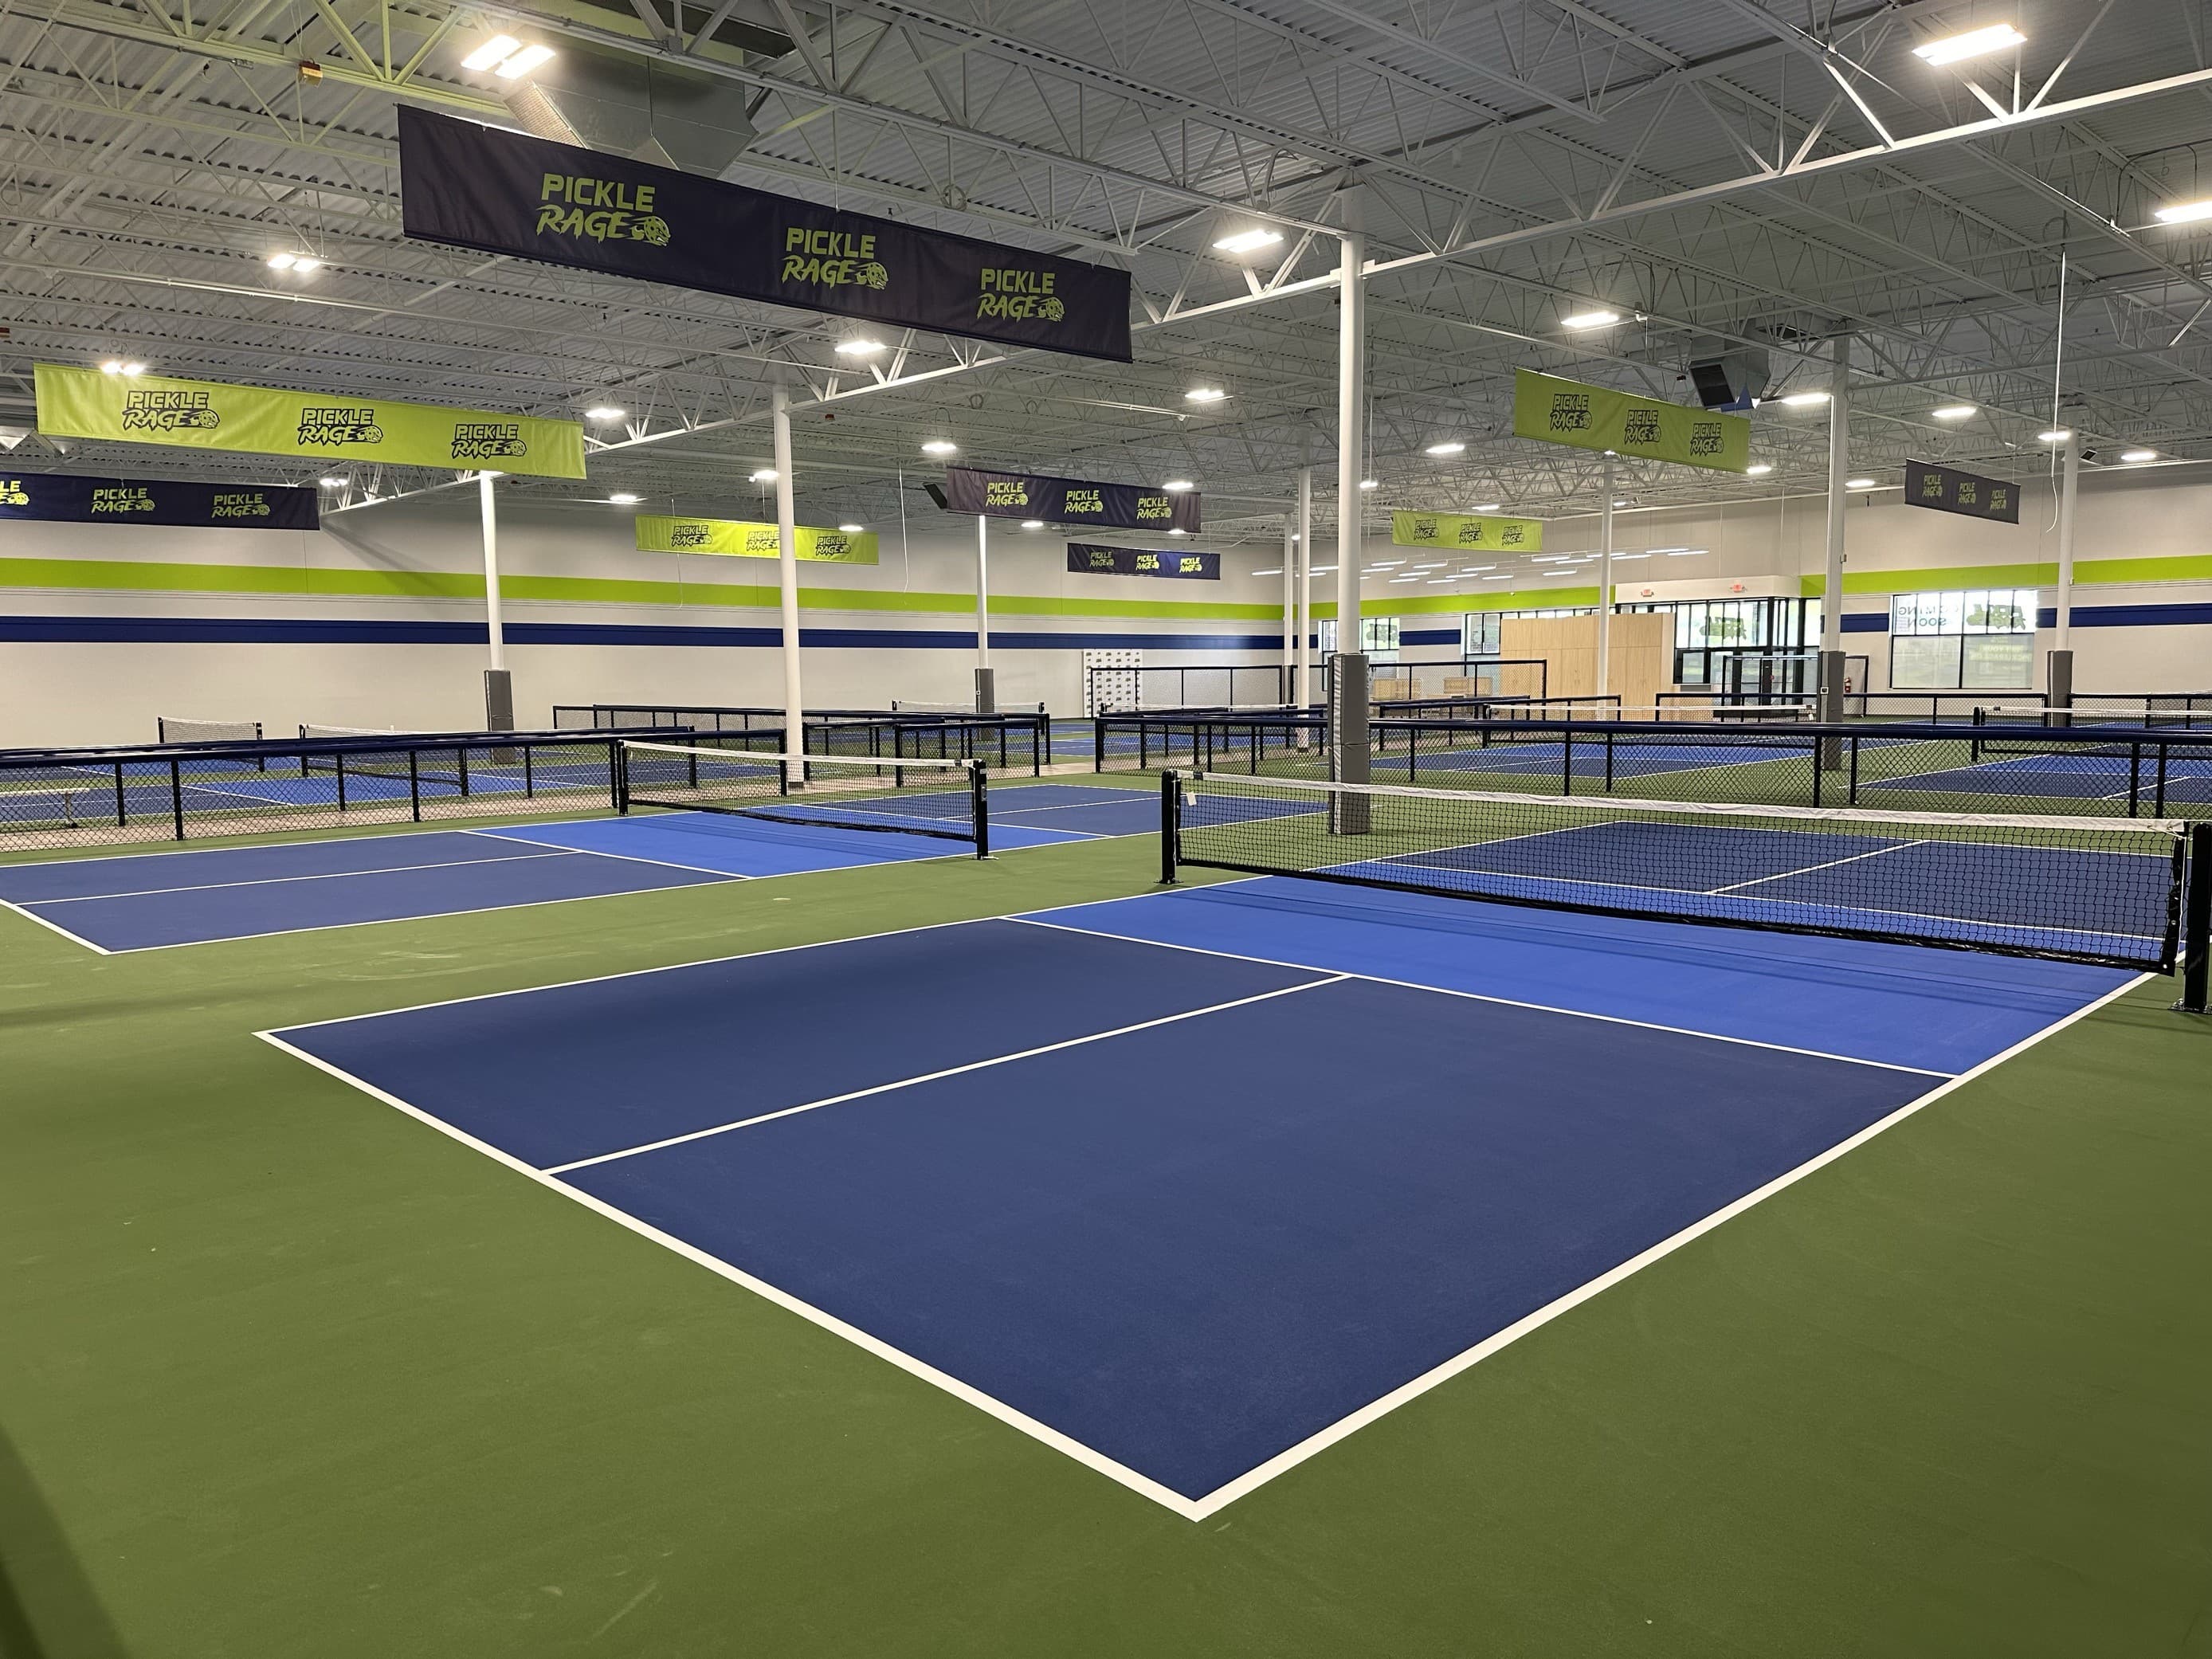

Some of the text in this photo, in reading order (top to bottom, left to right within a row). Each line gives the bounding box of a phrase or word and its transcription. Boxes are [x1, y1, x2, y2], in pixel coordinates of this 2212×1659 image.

[541, 172, 656, 213] PICKLE
[535, 204, 635, 244] RAGE
[786, 227, 876, 260] PICKLE
[782, 254, 860, 289] RAGE
[981, 268, 1056, 294] PICKLE
[977, 292, 1041, 323] RAGE
[127, 390, 209, 410] PICKLE
[1552, 394, 1589, 411] PICKLE
[122, 407, 192, 432] RAGE
[302, 408, 375, 426] PICKLE
[1549, 410, 1581, 433] RAGE
[297, 424, 358, 446] RAGE
[454, 424, 519, 440] PICKLE
[1624, 425, 1650, 445] RAGE
[1692, 422, 1722, 438] PICKLE
[451, 438, 505, 459] RAGE
[1690, 437, 1715, 457] RAGE
[93, 488, 147, 500] PICKLE
[987, 482, 1024, 493] PICKLE
[1066, 490, 1100, 501] PICKLE
[91, 500, 136, 514] RAGE
[214, 493, 263, 505] PICKLE
[986, 493, 1016, 507] RAGE
[1065, 500, 1092, 514] RAGE
[1137, 496, 1168, 508] PICKLE
[211, 504, 253, 518] RAGE
[1136, 507, 1162, 520] RAGE
[673, 525, 708, 535] PICKLE
[748, 530, 780, 541] PICKLE
[671, 535, 703, 547] RAGE
[817, 535, 847, 546] PICKLE
[815, 544, 841, 556] RAGE
